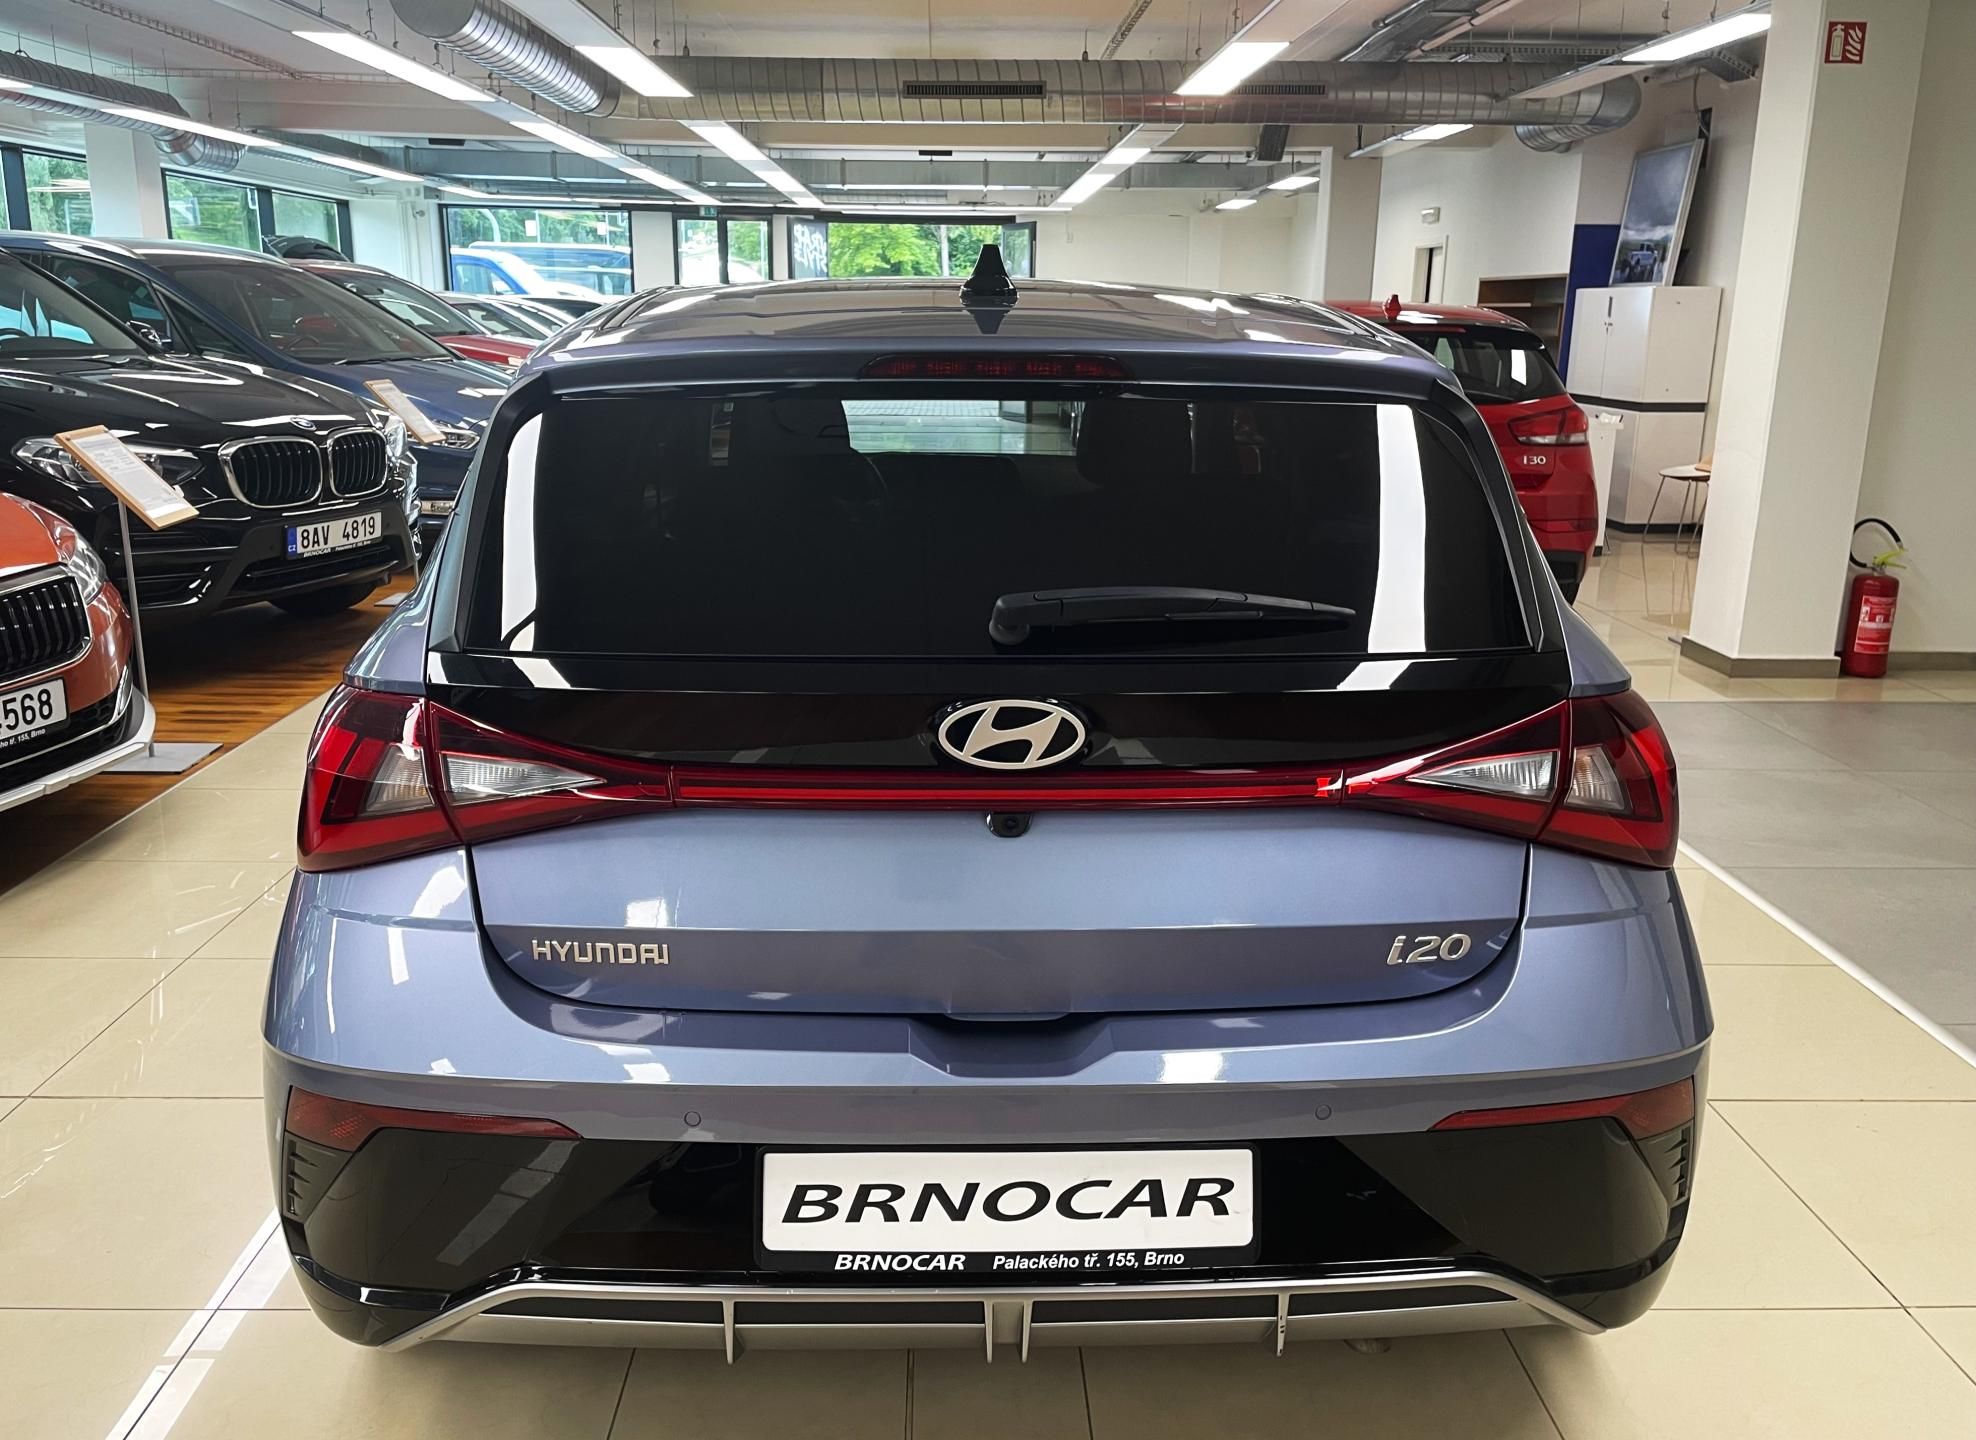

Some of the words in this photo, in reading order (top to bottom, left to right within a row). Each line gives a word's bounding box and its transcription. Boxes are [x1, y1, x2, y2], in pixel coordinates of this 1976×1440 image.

[288, 544, 296, 552] CZ
[301, 524, 330, 549] 8AV
[342, 516, 376, 541] 4819
[0, 688, 53, 736] 568
[531, 939, 669, 965] HYUNDAI
[1386, 933, 1472, 965] i20
[781, 1178, 1235, 1223] BRNOCAR
[834, 1254, 966, 1271] BRNOCAR
[992, 1253, 1079, 1270] Palackého
[1084, 1252, 1101, 1268] tř.
[1106, 1252, 1139, 1269] 155,
[1144, 1251, 1185, 1266] Brno
